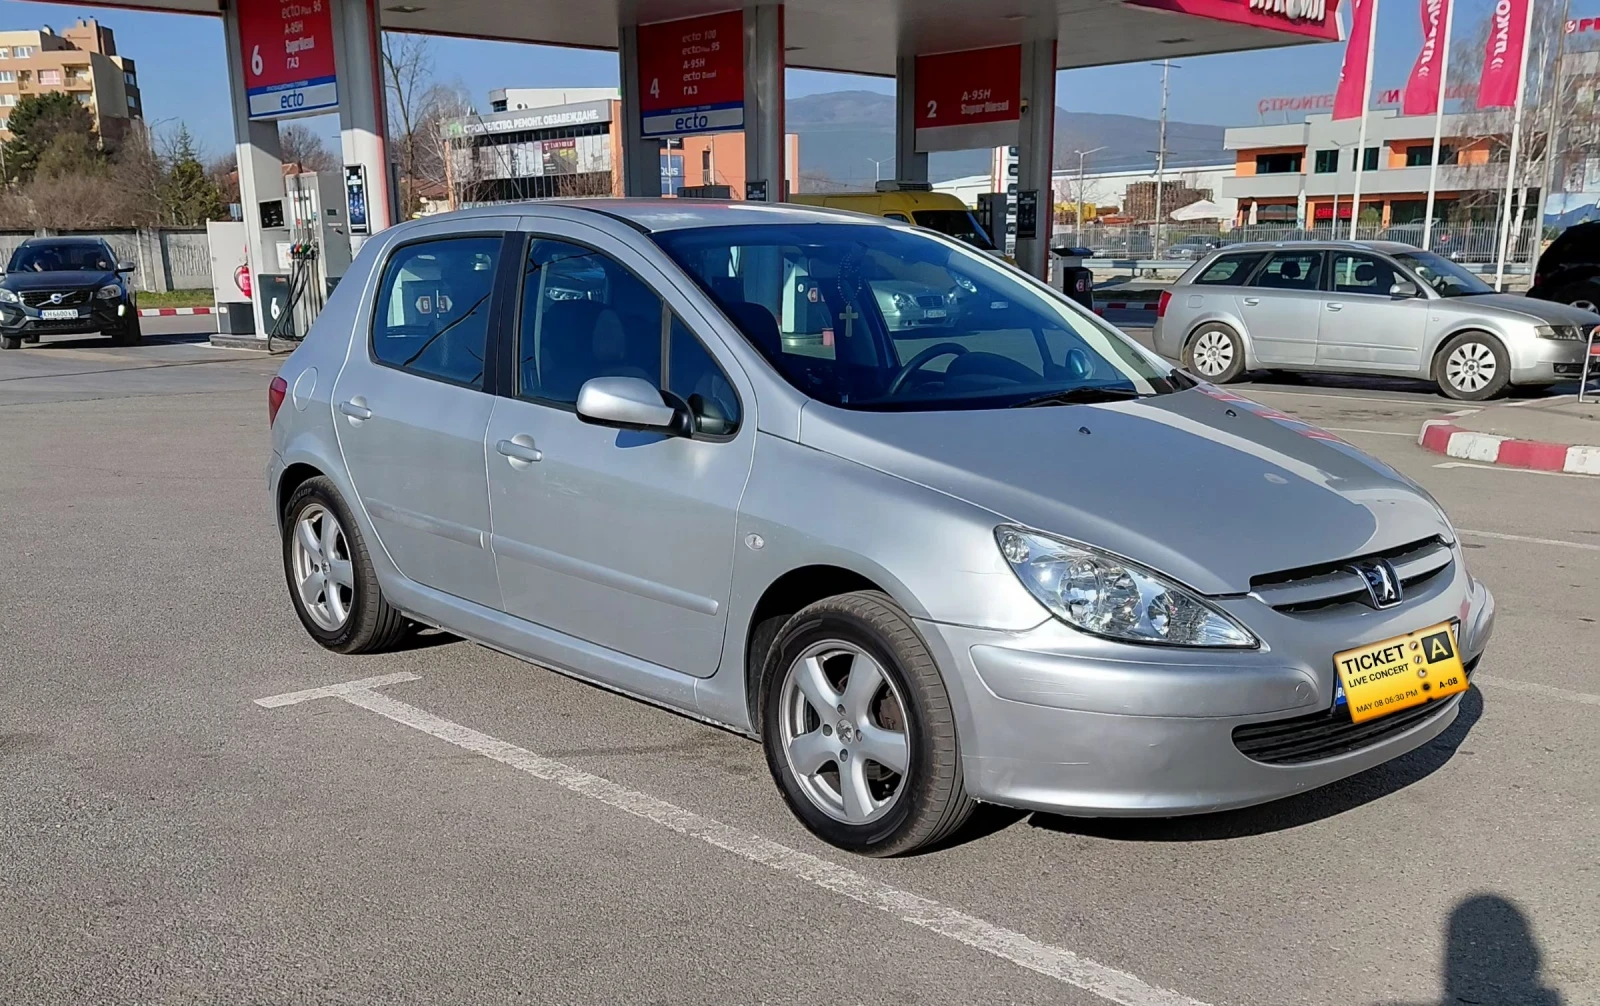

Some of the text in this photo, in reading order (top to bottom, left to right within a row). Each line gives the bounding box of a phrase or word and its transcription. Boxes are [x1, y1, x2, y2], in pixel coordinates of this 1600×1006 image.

[682, 32, 701, 42] ecto
[251, 44, 263, 76] 6
[683, 70, 701, 81] ecto
[649, 77, 660, 98] 4
[683, 85, 698, 95] ГАЗ
[280, 89, 304, 108] ecto
[926, 100, 937, 118] 2
[675, 111, 708, 130] ecto
[270, 297, 280, 320] 6
